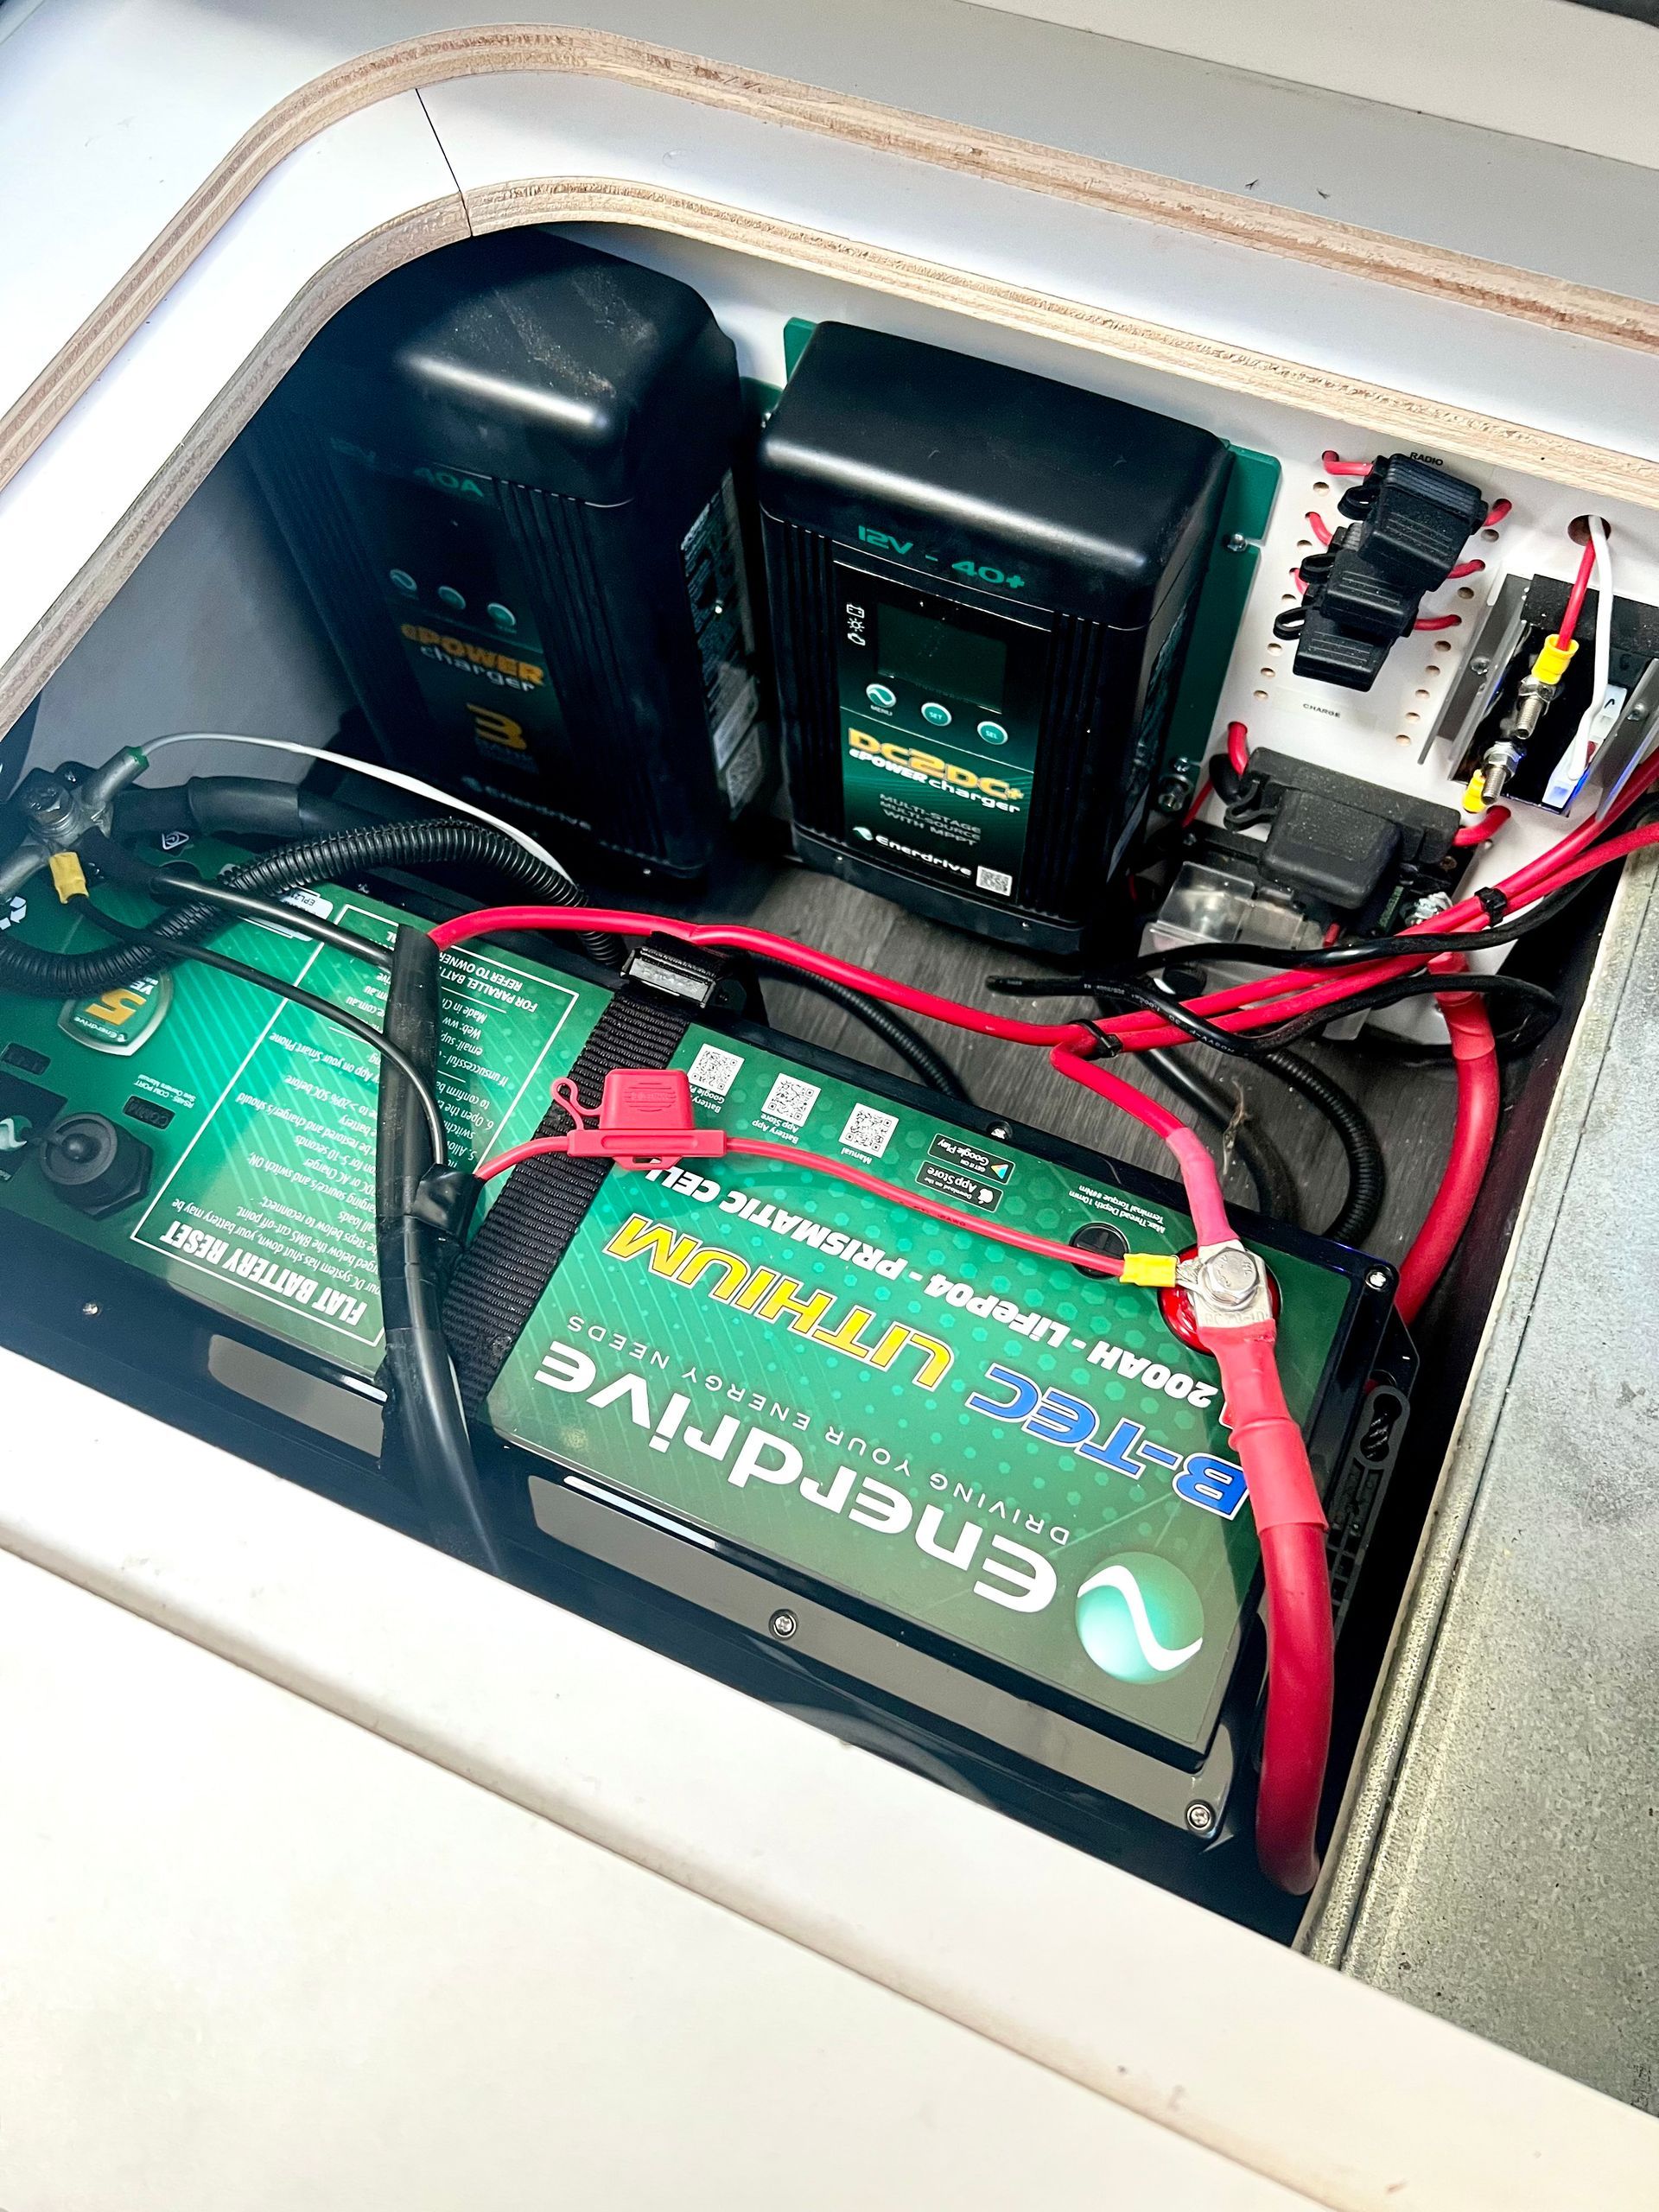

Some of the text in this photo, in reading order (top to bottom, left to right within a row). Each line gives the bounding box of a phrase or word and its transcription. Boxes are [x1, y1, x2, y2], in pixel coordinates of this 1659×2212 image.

[1410, 451, 1443, 466] RADIO
[858, 526, 912, 555] 12V
[951, 561, 1024, 588] 40+
[421, 645, 537, 692] charger
[1303, 702, 1341, 720] CHARGE
[467, 702, 527, 750] 3
[985, 730, 997, 739] SEL
[848, 727, 1024, 800] DC2DC+
[927, 778, 1021, 813] charger
[880, 792, 982, 835] MULTI-STAGE
[880, 800, 982, 842] MULTI-SOURCE
[882, 808, 977, 847] WITH MPPT
[875, 836, 972, 879] Enerdrive
[475, 966, 490, 978] TO
[487, 970, 523, 992] REFER
[464, 976, 516, 1004] PARALLEL
[83, 980, 148, 1029] 5
[450, 1002, 463, 1014] in
[513, 995, 538, 1013] FOR
[461, 1005, 487, 1024] Made
[73, 1014, 118, 1039] Enerdrive
[458, 1022, 482, 1039] Web:
[268, 1031, 299, 1051] Phone
[453, 1039, 483, 1059] email:
[294, 1042, 323, 1061] Smart
[321, 1050, 345, 1068] your
[342, 1061, 354, 1072] on
[353, 1065, 374, 1081] App
[446, 1053, 501, 1084] unsuccessful
[132, 1077, 154, 1091] PORT
[283, 1073, 313, 1093] before
[235, 1091, 267, 1112] should
[443, 1085, 480, 1109] confirm
[690, 1095, 721, 1113] Battery
[696, 1086, 726, 1103] Google
[356, 1104, 370, 1116] to
[442, 1102, 461, 1116] the
[477, 1099, 490, 1111] to
[336, 1113, 372, 1136] battery
[459, 1106, 486, 1126] Open
[482, 1118, 495, 1130] 6.
[759, 1112, 800, 1133] App Store
[303, 1120, 324, 1135] and
[750, 1118, 800, 1143] Battery App
[292, 1134, 329, 1156] seconds
[321, 1127, 359, 1151] restored
[356, 1141, 372, 1155] be
[325, 1147, 350, 1165] 5-10
[840, 1146, 873, 1165] Manual
[936, 1137, 991, 1166] Google Play
[262, 1160, 293, 1180] switch
[302, 1155, 340, 1179] Charger
[347, 1156, 363, 1171] for
[289, 1171, 310, 1187] and
[334, 1171, 351, 1185] AC
[348, 1176, 361, 1188] or
[923, 1175, 934, 1184] the
[925, 1166, 978, 1192] App Store
[307, 1177, 347, 1203] source/s
[942, 1183, 973, 1199] Download
[1067, 1189, 1094, 1205] 10mm
[170, 1197, 186, 1210] be
[183, 1201, 206, 1217] may
[257, 1195, 307, 1224] reconnect;
[1093, 1198, 1120, 1215] Depth
[1102, 1192, 1130, 1209] Torque
[200, 1209, 238, 1234] battery
[233, 1205, 263, 1224] point.
[303, 1216, 320, 1229] to
[335, 1210, 363, 1229] loads
[1129, 1204, 1164, 1223] Terminal
[234, 1223, 257, 1239] your
[257, 1216, 292, 1238] cut-off
[316, 1221, 344, 1240] below
[359, 1220, 375, 1234] all
[717, 1185, 908, 1283] PRISMATIC
[253, 1232, 283, 1253] down,
[289, 1230, 313, 1246] BMS
[310, 1238, 327, 1252] the
[341, 1230, 369, 1249] steps
[279, 1245, 305, 1263] shut
[302, 1255, 321, 1269] has
[325, 1244, 356, 1265] below
[158, 1218, 368, 1325] FLAT BATTERY RESET
[319, 1260, 354, 1282] system
[349, 1275, 365, 1289] DC
[600, 1208, 1257, 1518] B-TEC LITHIUM
[1084, 1337, 1219, 1411] 200AH
[563, 1313, 1072, 1545] DRIVING YOUR ENERGY NEEDS
[522, 1342, 1070, 1617] Enerdrive
